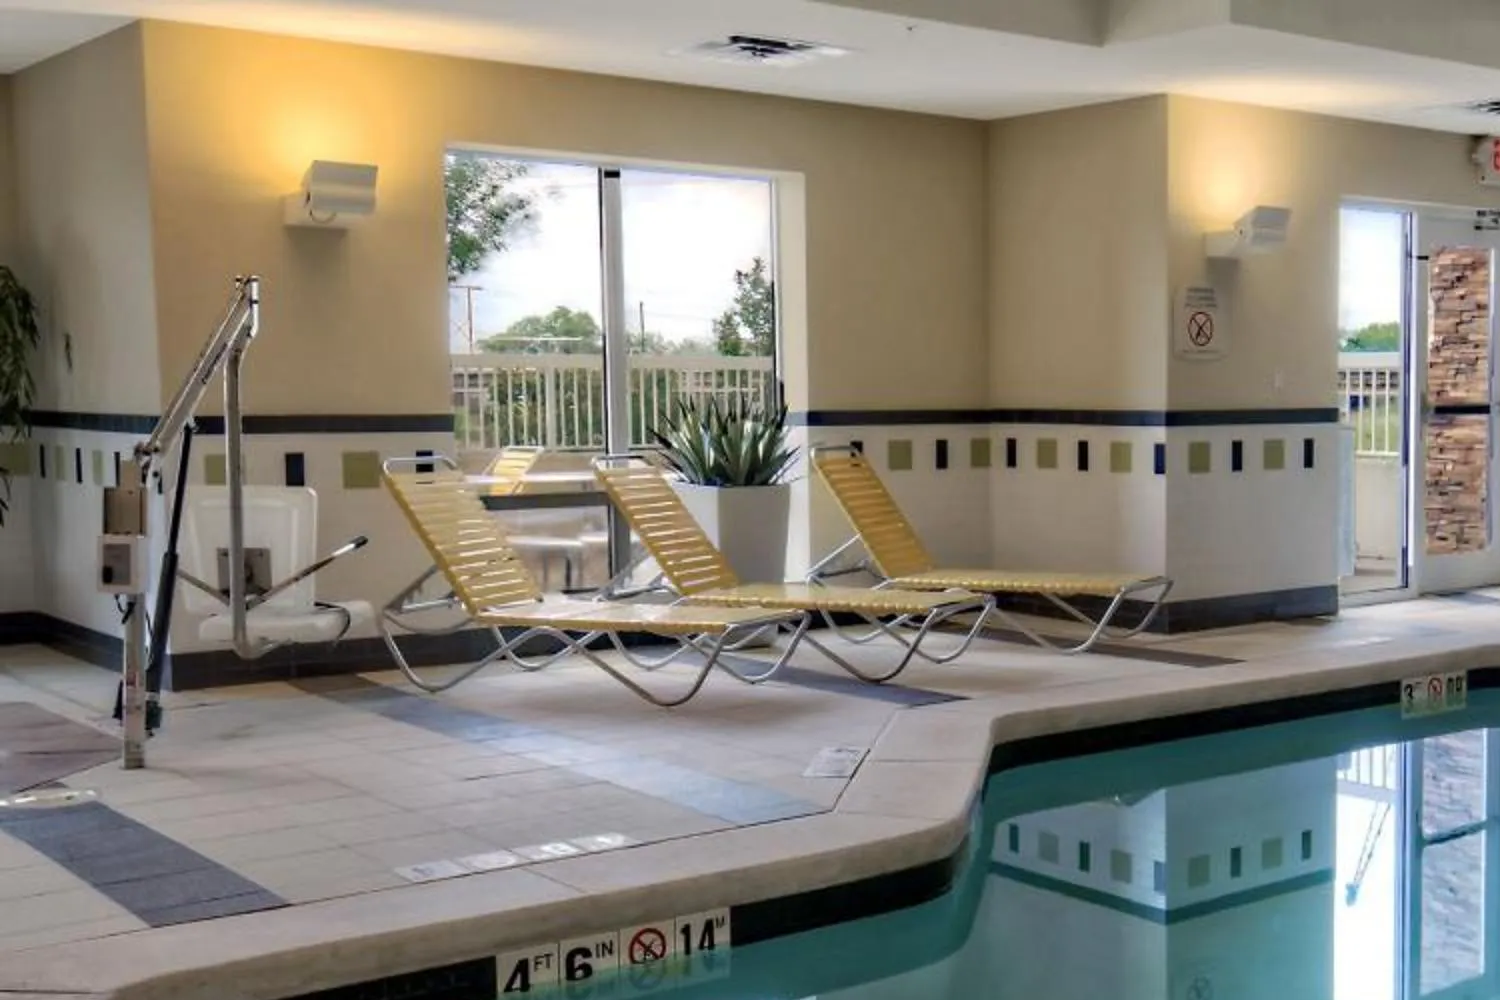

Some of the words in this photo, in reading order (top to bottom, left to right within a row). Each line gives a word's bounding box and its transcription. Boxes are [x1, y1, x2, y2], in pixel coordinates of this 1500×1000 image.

[503, 957, 531, 993] 4
[534, 953, 553, 973] FT
[565, 947, 593, 981] 6
[595, 939, 614, 959] IN
